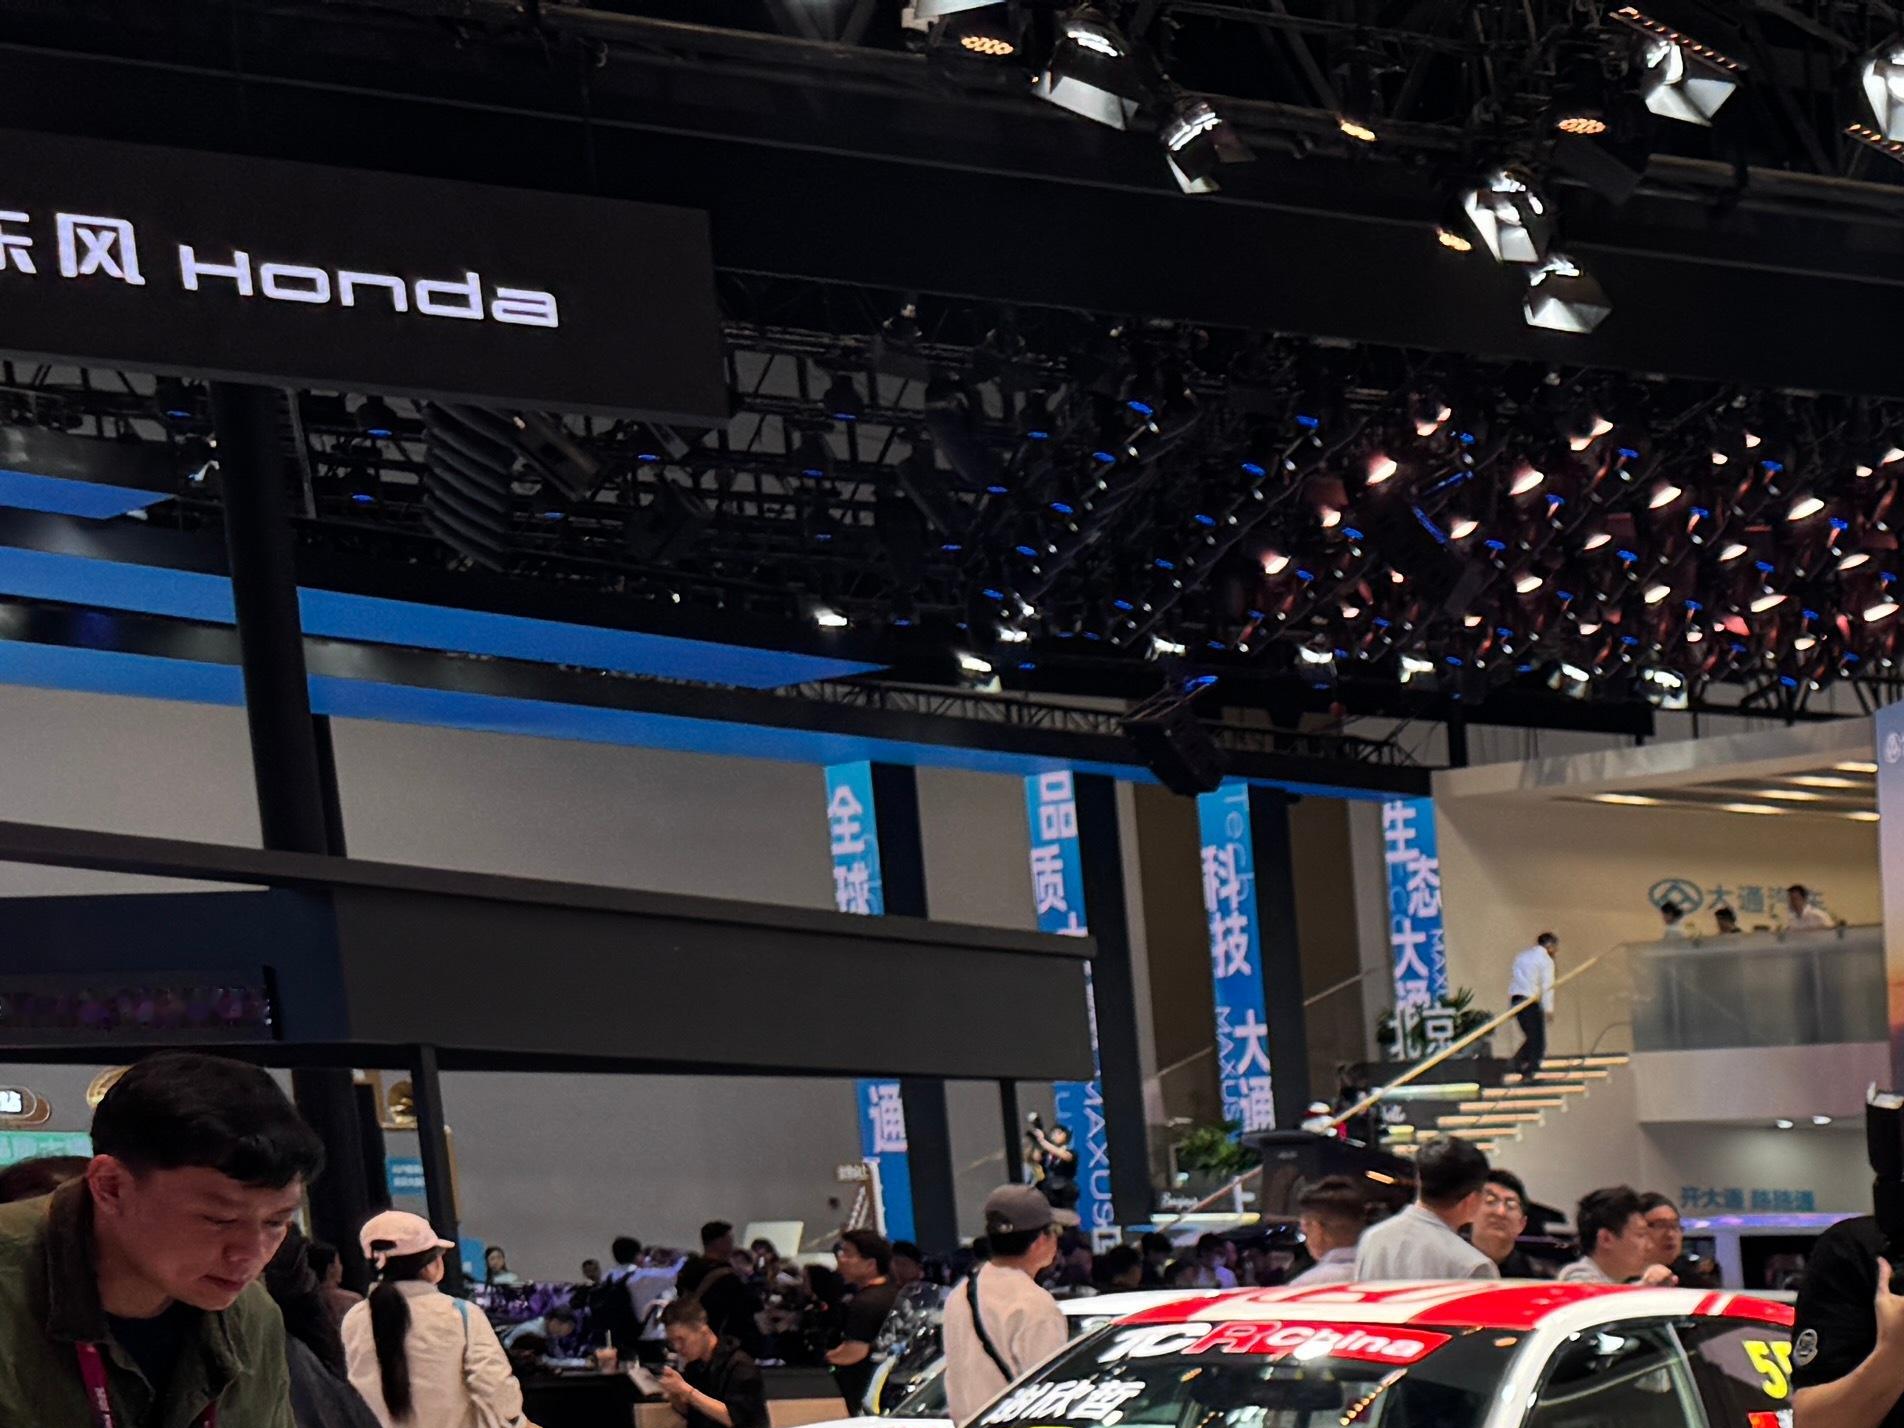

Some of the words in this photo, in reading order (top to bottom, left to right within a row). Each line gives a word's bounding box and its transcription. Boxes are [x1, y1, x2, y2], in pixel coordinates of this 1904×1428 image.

[179, 242, 560, 330] Honda
[826, 784, 872, 915] 全球
[1029, 770, 1078, 915] 品质
[1382, 800, 1442, 919] 生态
[1201, 843, 1253, 979] 科技
[1232, 1008, 1276, 1131] 大通
[1387, 1003, 1458, 1059] 北京
[1267, 1325, 1427, 1362] China
